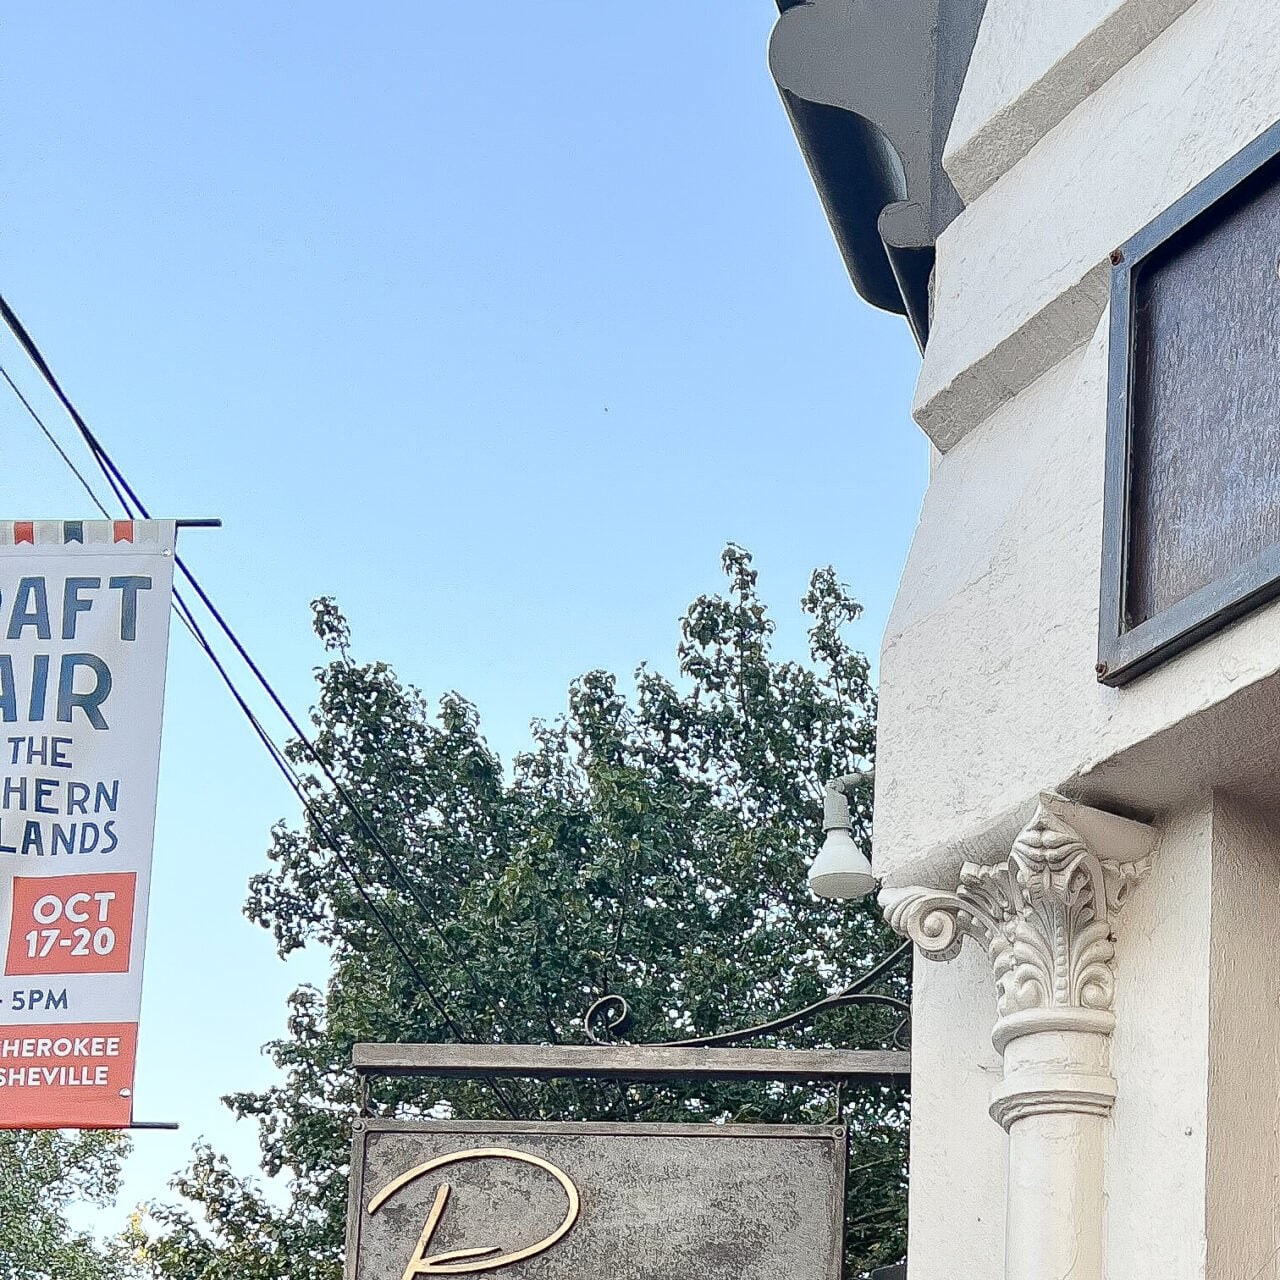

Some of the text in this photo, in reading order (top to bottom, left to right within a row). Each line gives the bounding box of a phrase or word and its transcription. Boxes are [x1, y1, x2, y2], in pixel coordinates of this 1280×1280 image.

[0, 576, 152, 641] AFT
[8, 736, 73, 768] THE
[3, 777, 119, 815] HERN
[32, 891, 116, 924] OCT
[25, 926, 116, 958] 17-20
[11, 988, 68, 1011] 5PM
[0, 1036, 120, 1058] HEROKEE
